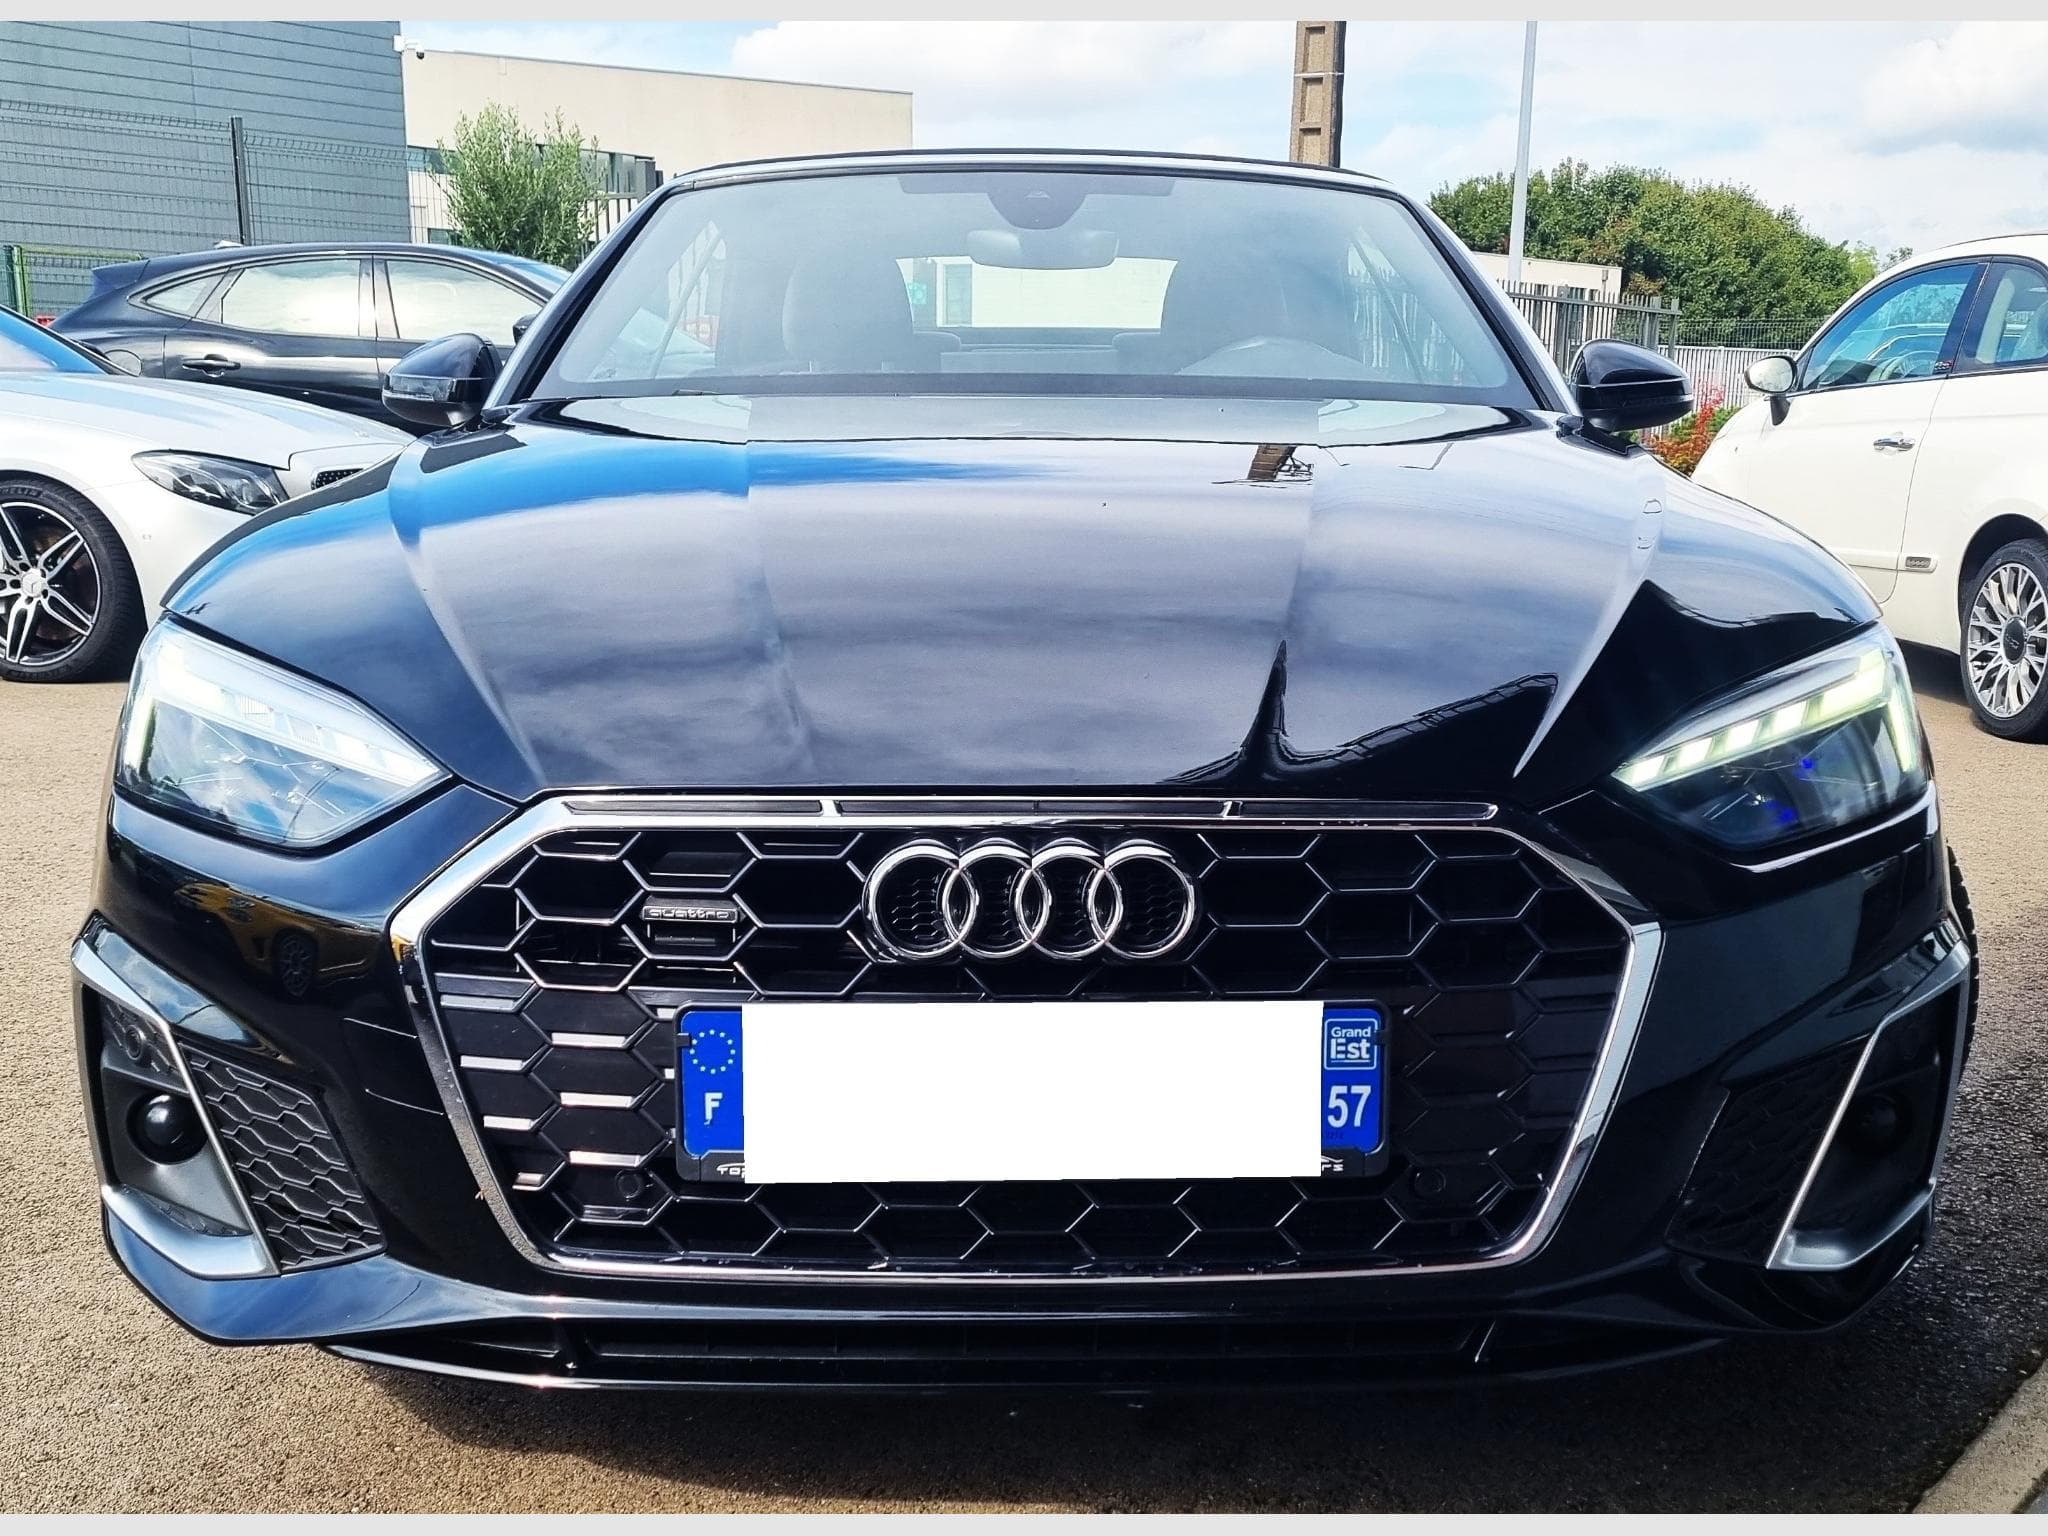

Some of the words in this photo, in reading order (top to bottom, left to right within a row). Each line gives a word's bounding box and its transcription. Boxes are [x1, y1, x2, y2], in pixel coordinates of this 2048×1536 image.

[648, 908, 730, 920] quattro
[1331, 1026, 1371, 1037] Grand
[1330, 1038, 1370, 1059] Est
[704, 1092, 723, 1121] F
[1327, 1085, 1371, 1128] 57
